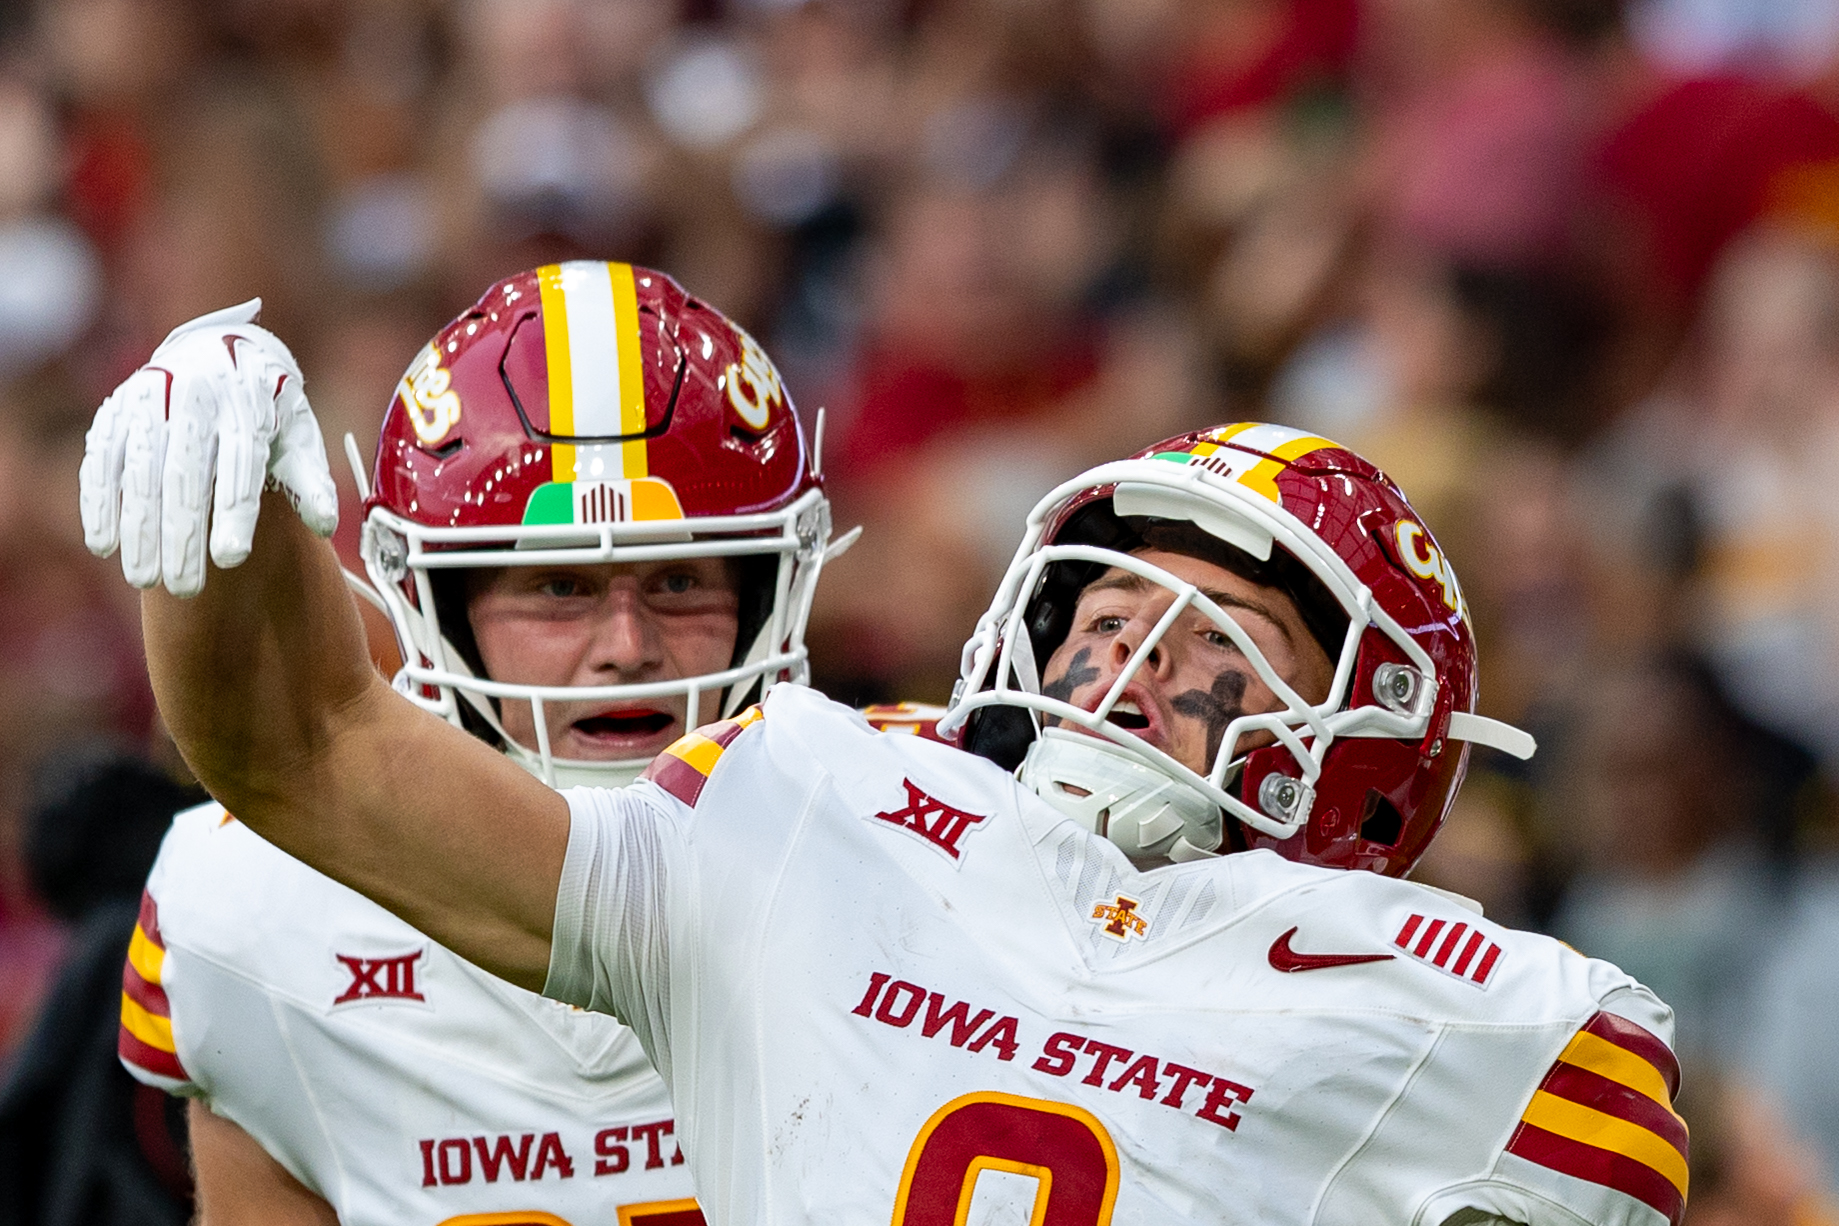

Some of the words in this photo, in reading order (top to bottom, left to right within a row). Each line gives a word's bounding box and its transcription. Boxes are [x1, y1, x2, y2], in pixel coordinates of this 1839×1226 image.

[874, 776, 987, 860] XII
[1091, 904, 1147, 936] STATE
[332, 949, 426, 1006] XII
[852, 972, 1019, 1061] IOWA
[1031, 1032, 1254, 1132] STATE
[419, 1133, 575, 1187] IOWA
